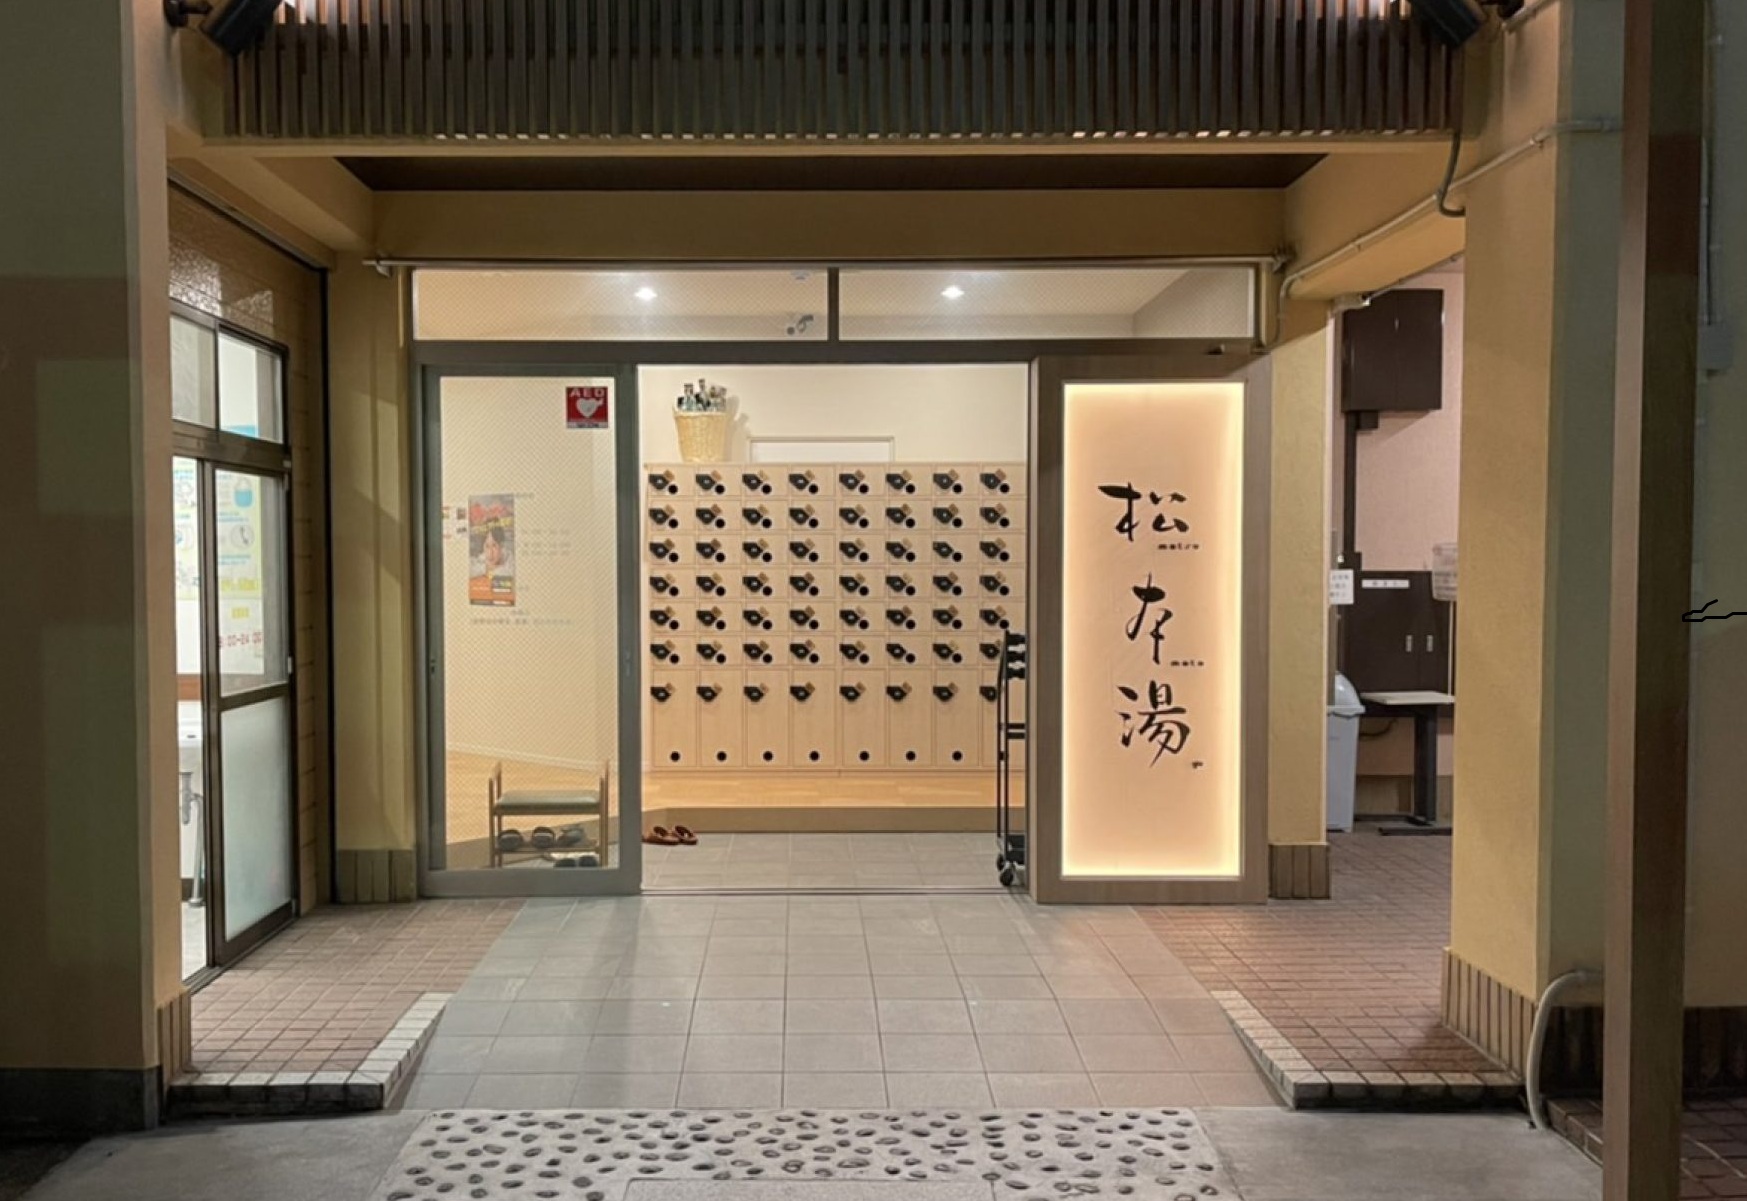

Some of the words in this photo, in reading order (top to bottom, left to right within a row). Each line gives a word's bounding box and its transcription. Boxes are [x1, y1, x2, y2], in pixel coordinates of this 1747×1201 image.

[569, 388, 605, 398] AED
[1098, 482, 1190, 767] 松本湯
